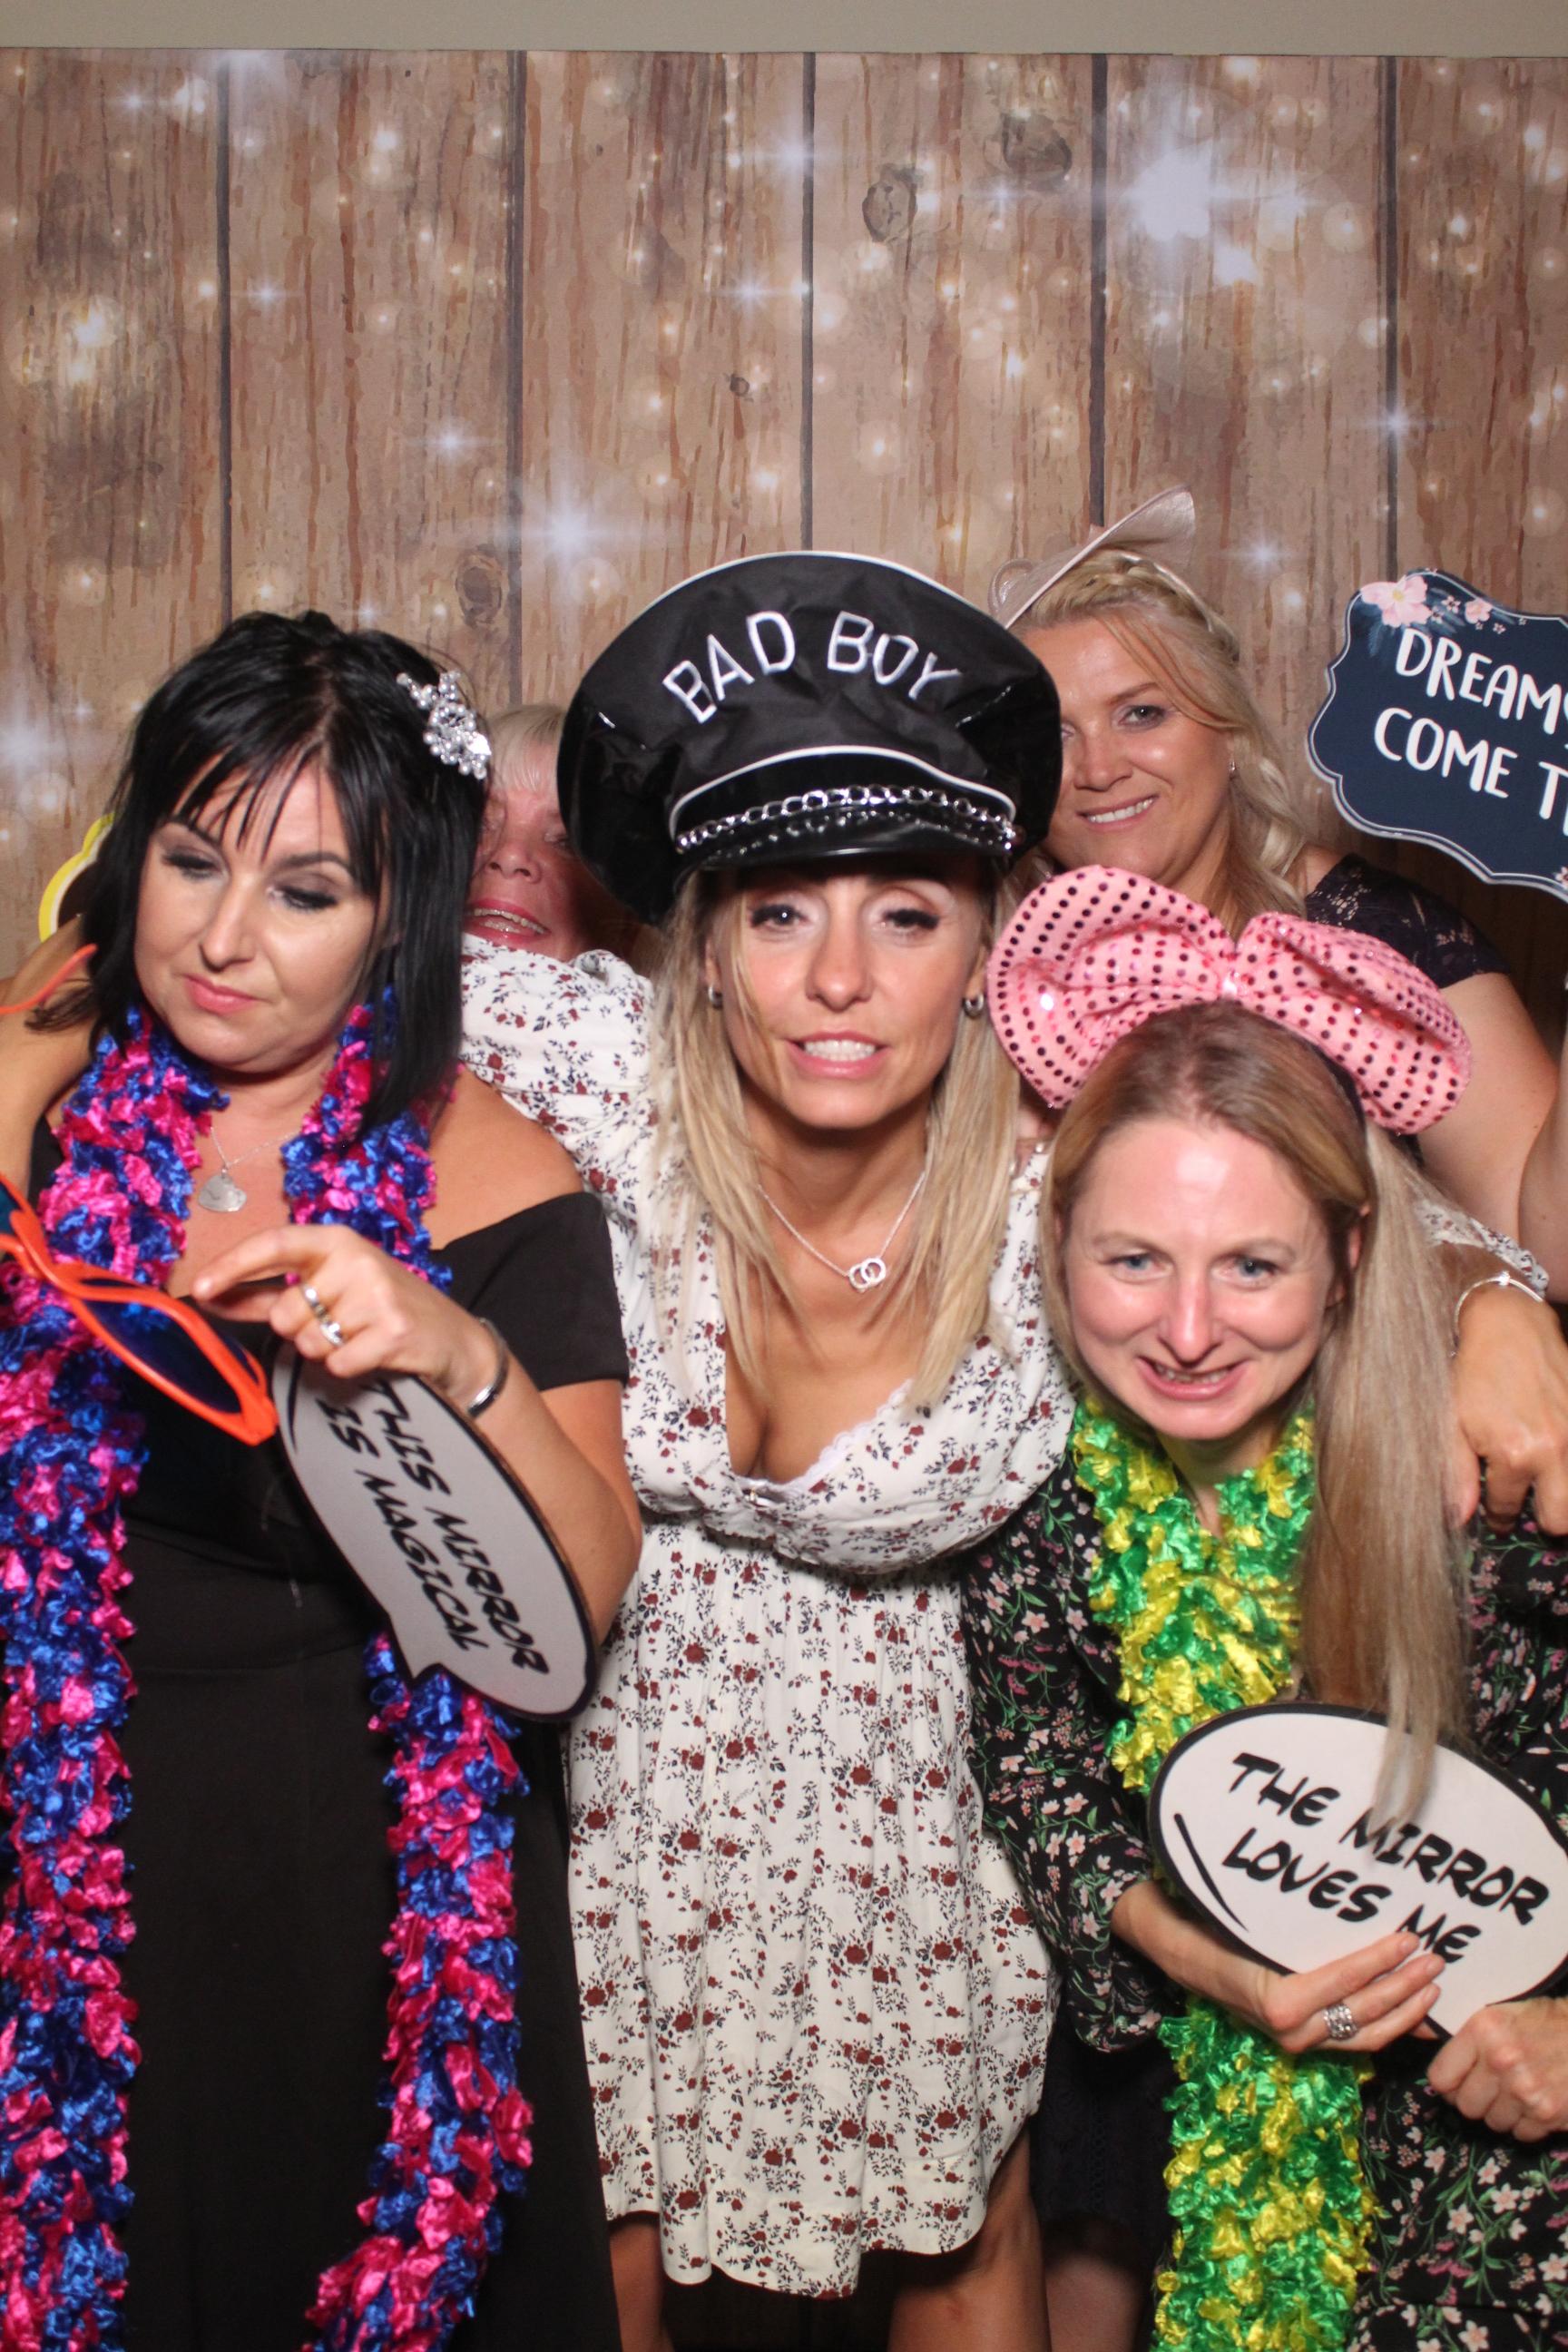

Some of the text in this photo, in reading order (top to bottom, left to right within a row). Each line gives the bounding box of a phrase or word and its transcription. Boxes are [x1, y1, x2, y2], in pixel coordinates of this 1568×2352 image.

[662, 611, 963, 724] BAD BOY
[1396, 628, 1568, 750] DREAM
[1374, 707, 1568, 837] COME T
[315, 1397, 489, 1651] IS MAGICAL
[359, 1378, 550, 1675] THIS MIRROR
[1221, 1827, 1482, 1964] LOVES ME
[1228, 1752, 1549, 1926] THE MIRROR
